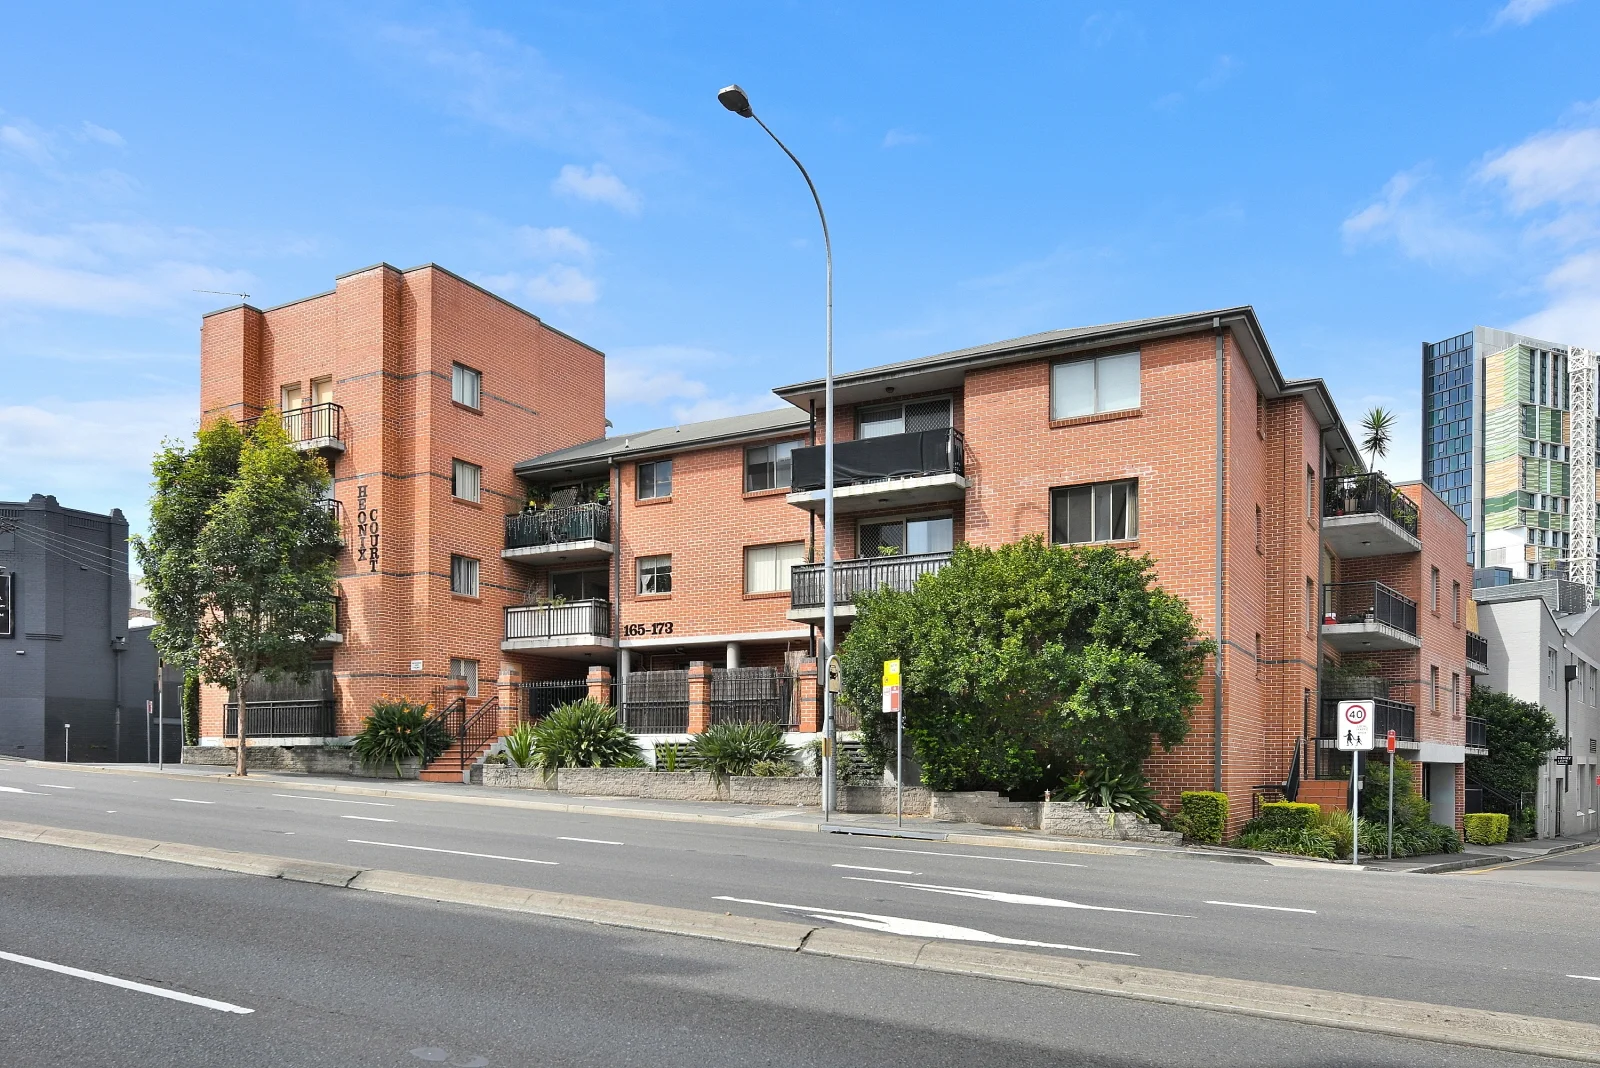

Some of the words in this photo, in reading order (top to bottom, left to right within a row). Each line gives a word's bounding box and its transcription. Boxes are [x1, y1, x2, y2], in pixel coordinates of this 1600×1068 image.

[357, 485, 368, 561] HEONIX
[369, 509, 380, 572] COURT
[623, 621, 674, 637] 165-173
[1349, 710, 1363, 719] 40
